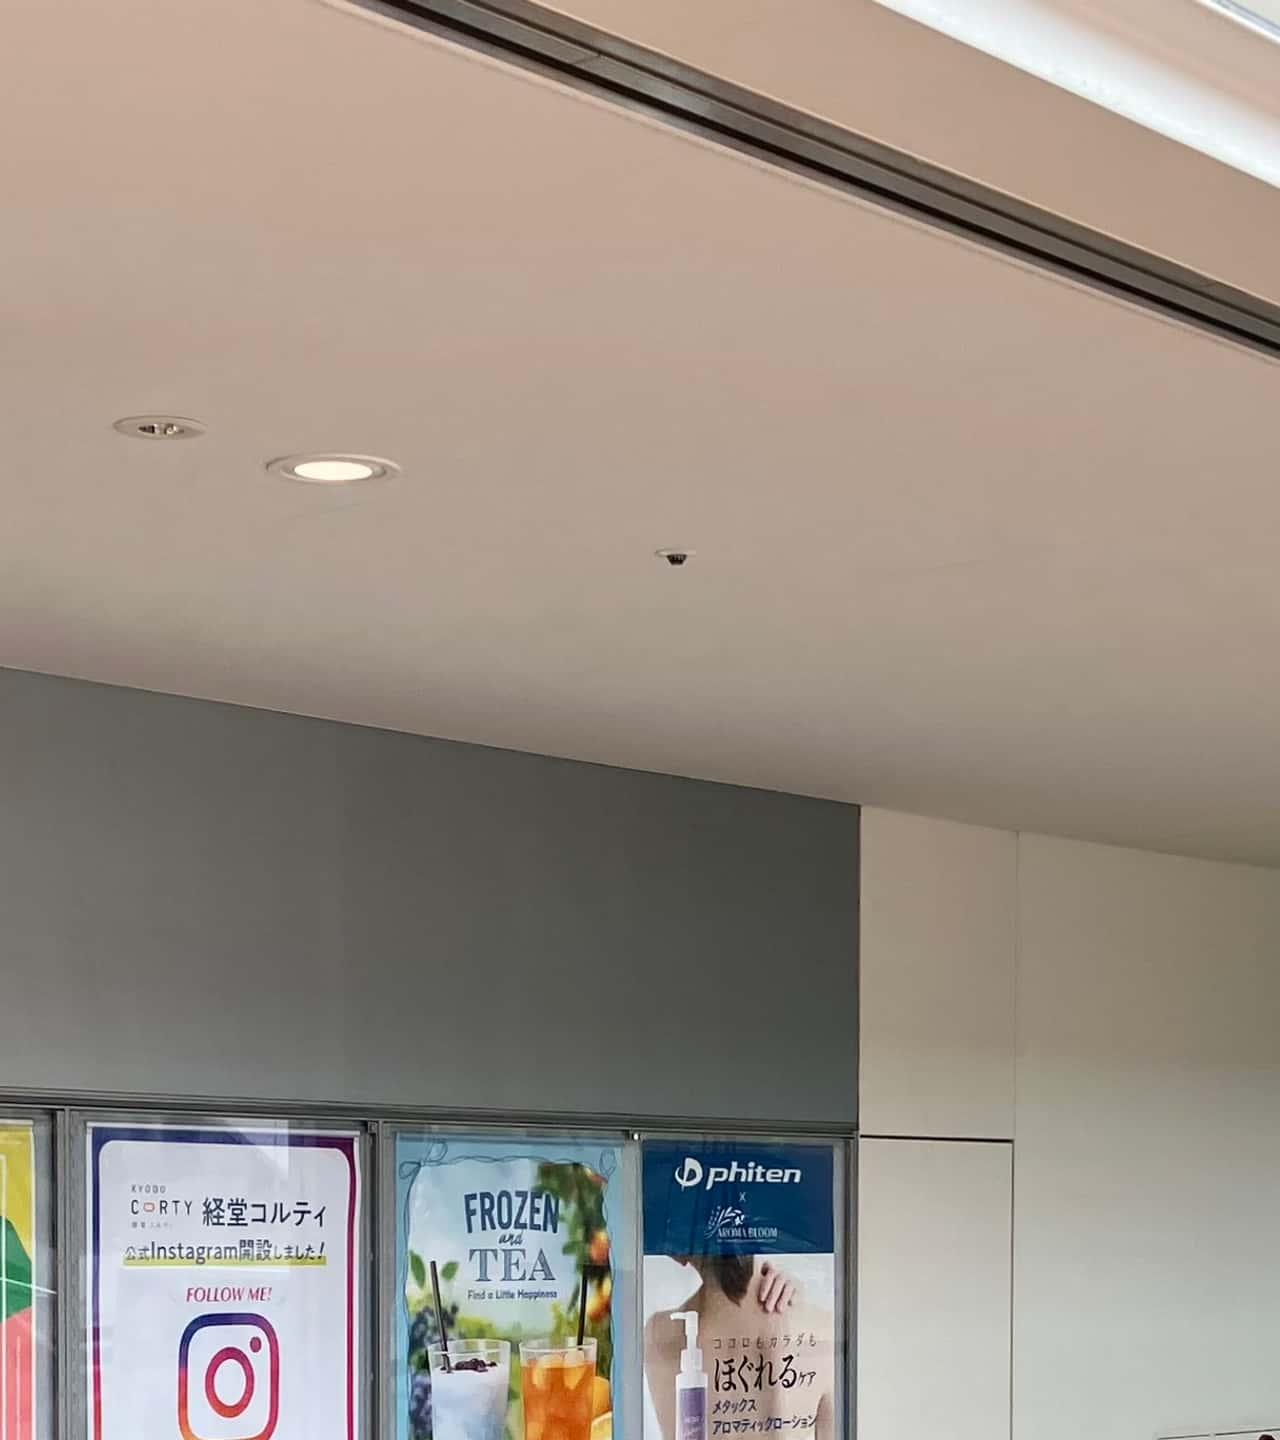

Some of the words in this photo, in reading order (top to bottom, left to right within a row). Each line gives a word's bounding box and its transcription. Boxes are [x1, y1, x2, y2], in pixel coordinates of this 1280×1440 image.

[706, 1161, 802, 1191] phiten
[131, 1199, 193, 1217] CORTY
[202, 1197, 327, 1228] 経堂コルティ
[464, 1190, 560, 1234] FROZEN
[498, 1231, 524, 1246] and
[125, 1239, 326, 1265] 公式Instagram開設しました!
[468, 1248, 557, 1283] TEA
[186, 1286, 245, 1302] FOLLOW
[247, 1286, 273, 1302] ME!
[467, 1289, 486, 1300] Find
[495, 1289, 516, 1300] Little
[517, 1288, 558, 1301] Happiness
[713, 1333, 817, 1350] ココロもカラダも
[714, 1354, 817, 1393] ほぐれるケア
[712, 1398, 758, 1415] メタックス
[712, 1415, 818, 1435] アロマティックローション
